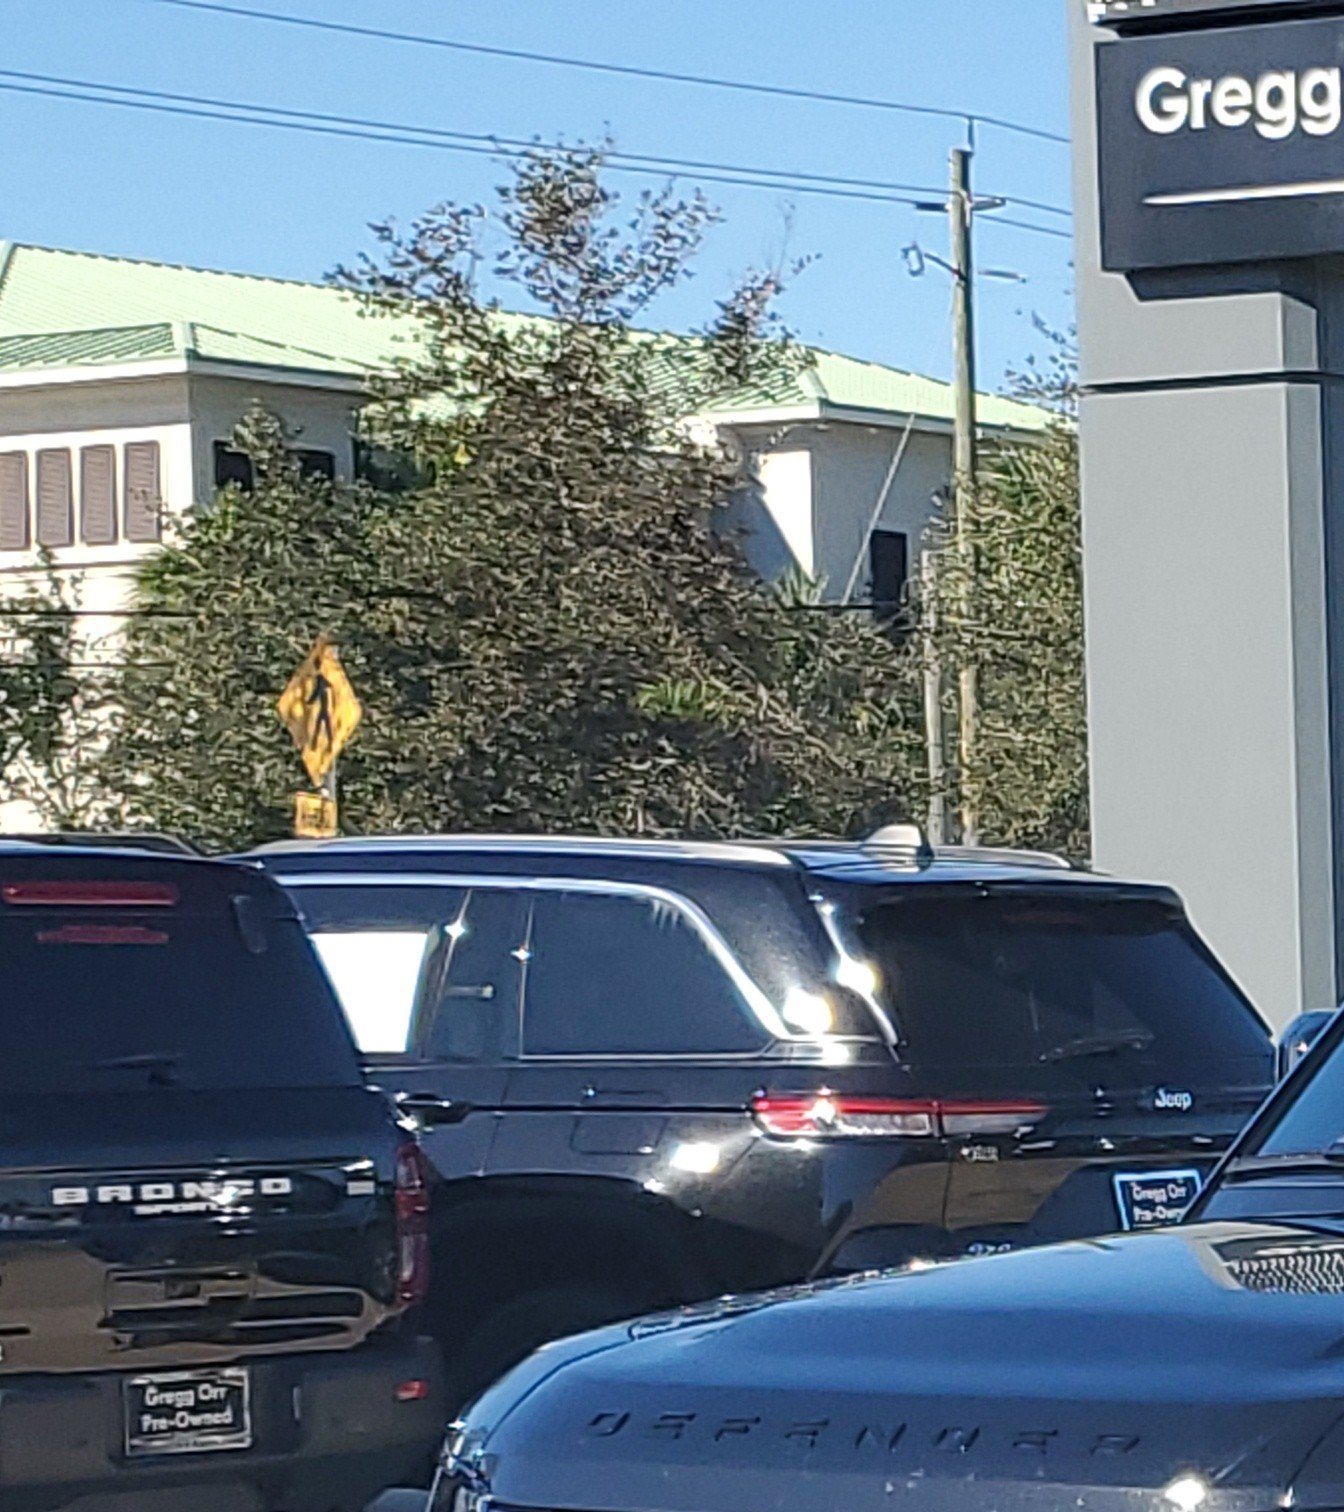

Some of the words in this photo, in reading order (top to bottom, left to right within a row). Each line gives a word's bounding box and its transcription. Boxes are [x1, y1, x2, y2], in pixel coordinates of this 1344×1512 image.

[1135, 66, 1342, 140] Gregg
[1154, 1088, 1192, 1111] Jeep
[52, 1178, 292, 1205] BRONCO
[145, 1385, 195, 1408] Gregg
[198, 1383, 228, 1401] Orr
[141, 1404, 233, 1432] Pre-Owned
